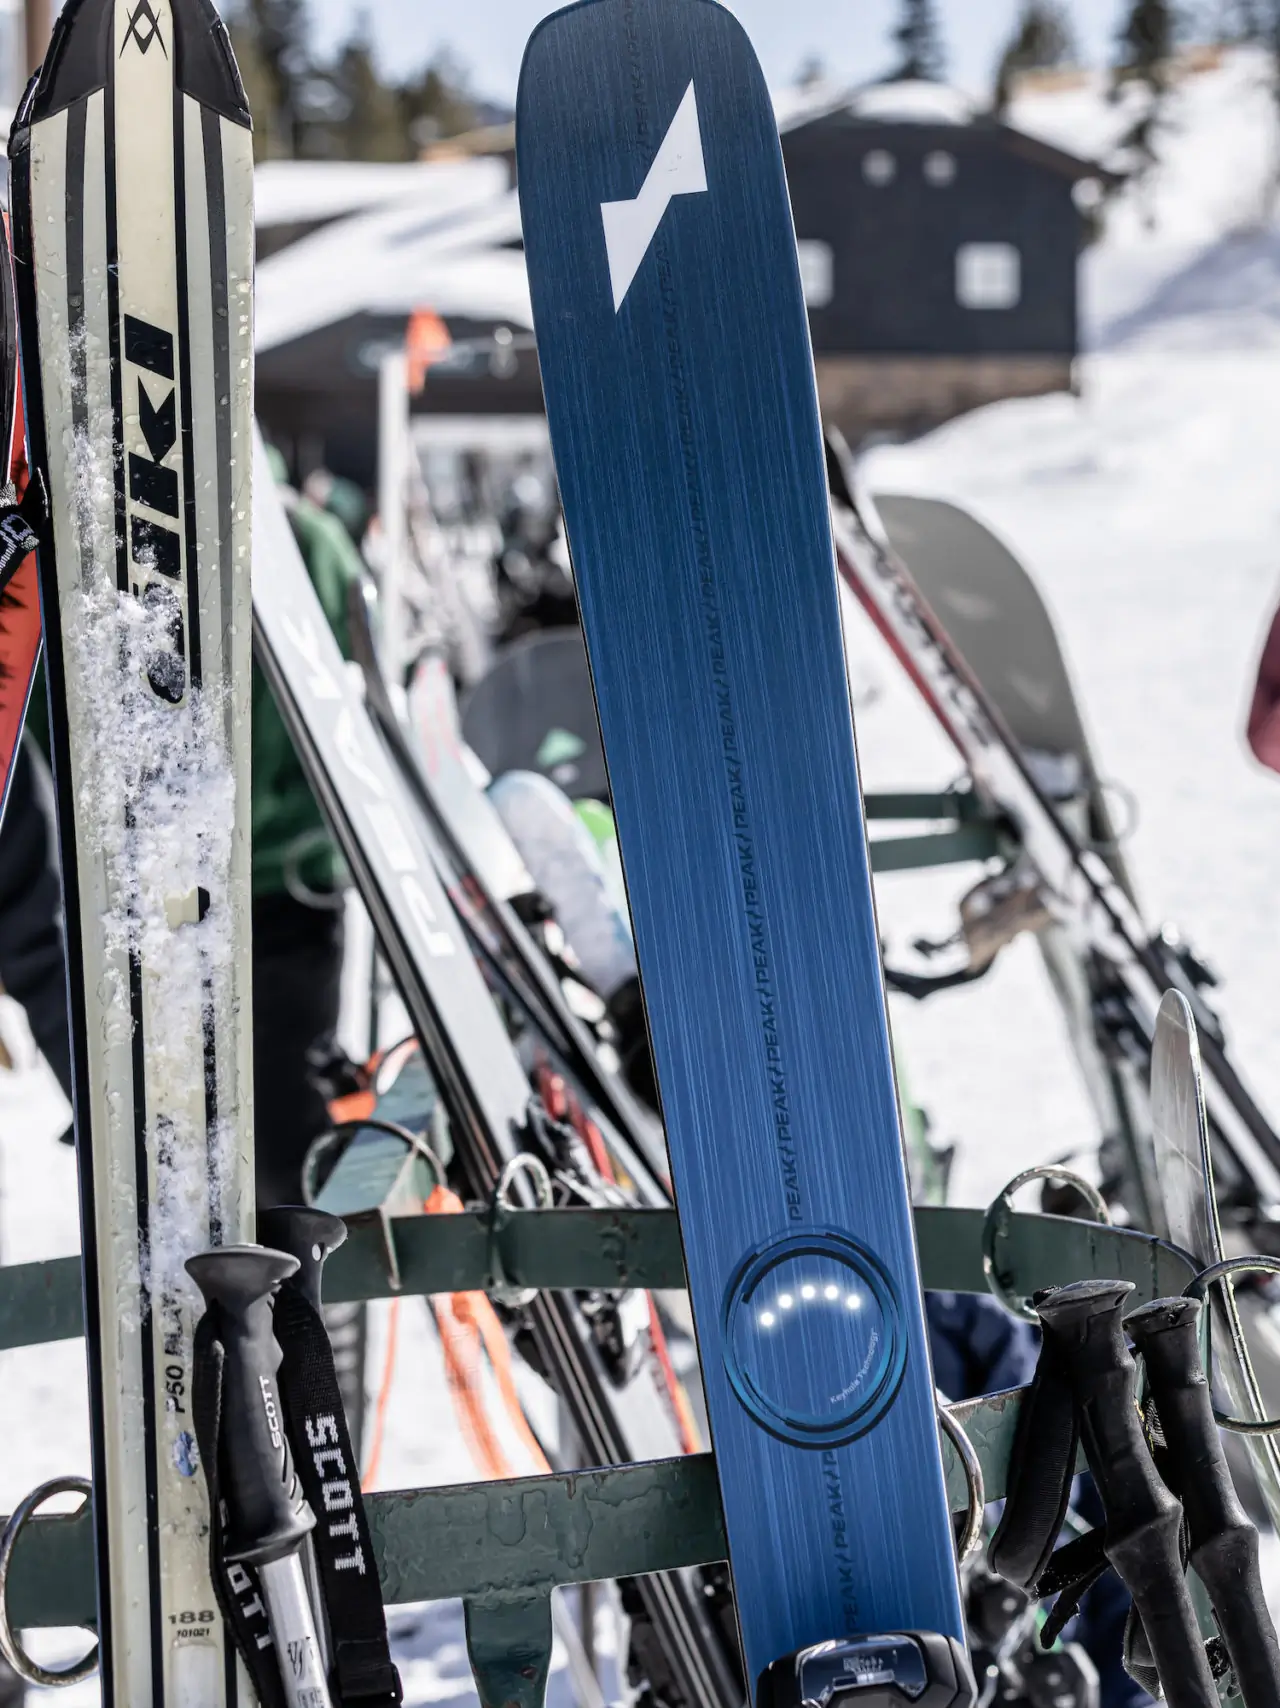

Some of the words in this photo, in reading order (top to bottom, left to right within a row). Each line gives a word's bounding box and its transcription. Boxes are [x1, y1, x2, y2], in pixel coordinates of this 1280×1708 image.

[717, 691, 736, 750] PEAK
[729, 768, 747, 828] PEAK
[740, 845, 758, 905] PEAK
[752, 923, 769, 980] PEAK
[761, 1000, 781, 1061] PEAK
[771, 1078, 792, 1141] PEAK
[783, 1159, 803, 1220] PEAK
[165, 1364, 185, 1413] P50
[259, 1375, 282, 1449] SCOTT
[830, 1378, 860, 1404] Keyhole
[305, 1413, 366, 1575] SCOTT
[829, 1485, 847, 1546] PEAK
[168, 1610, 215, 1624] 188
